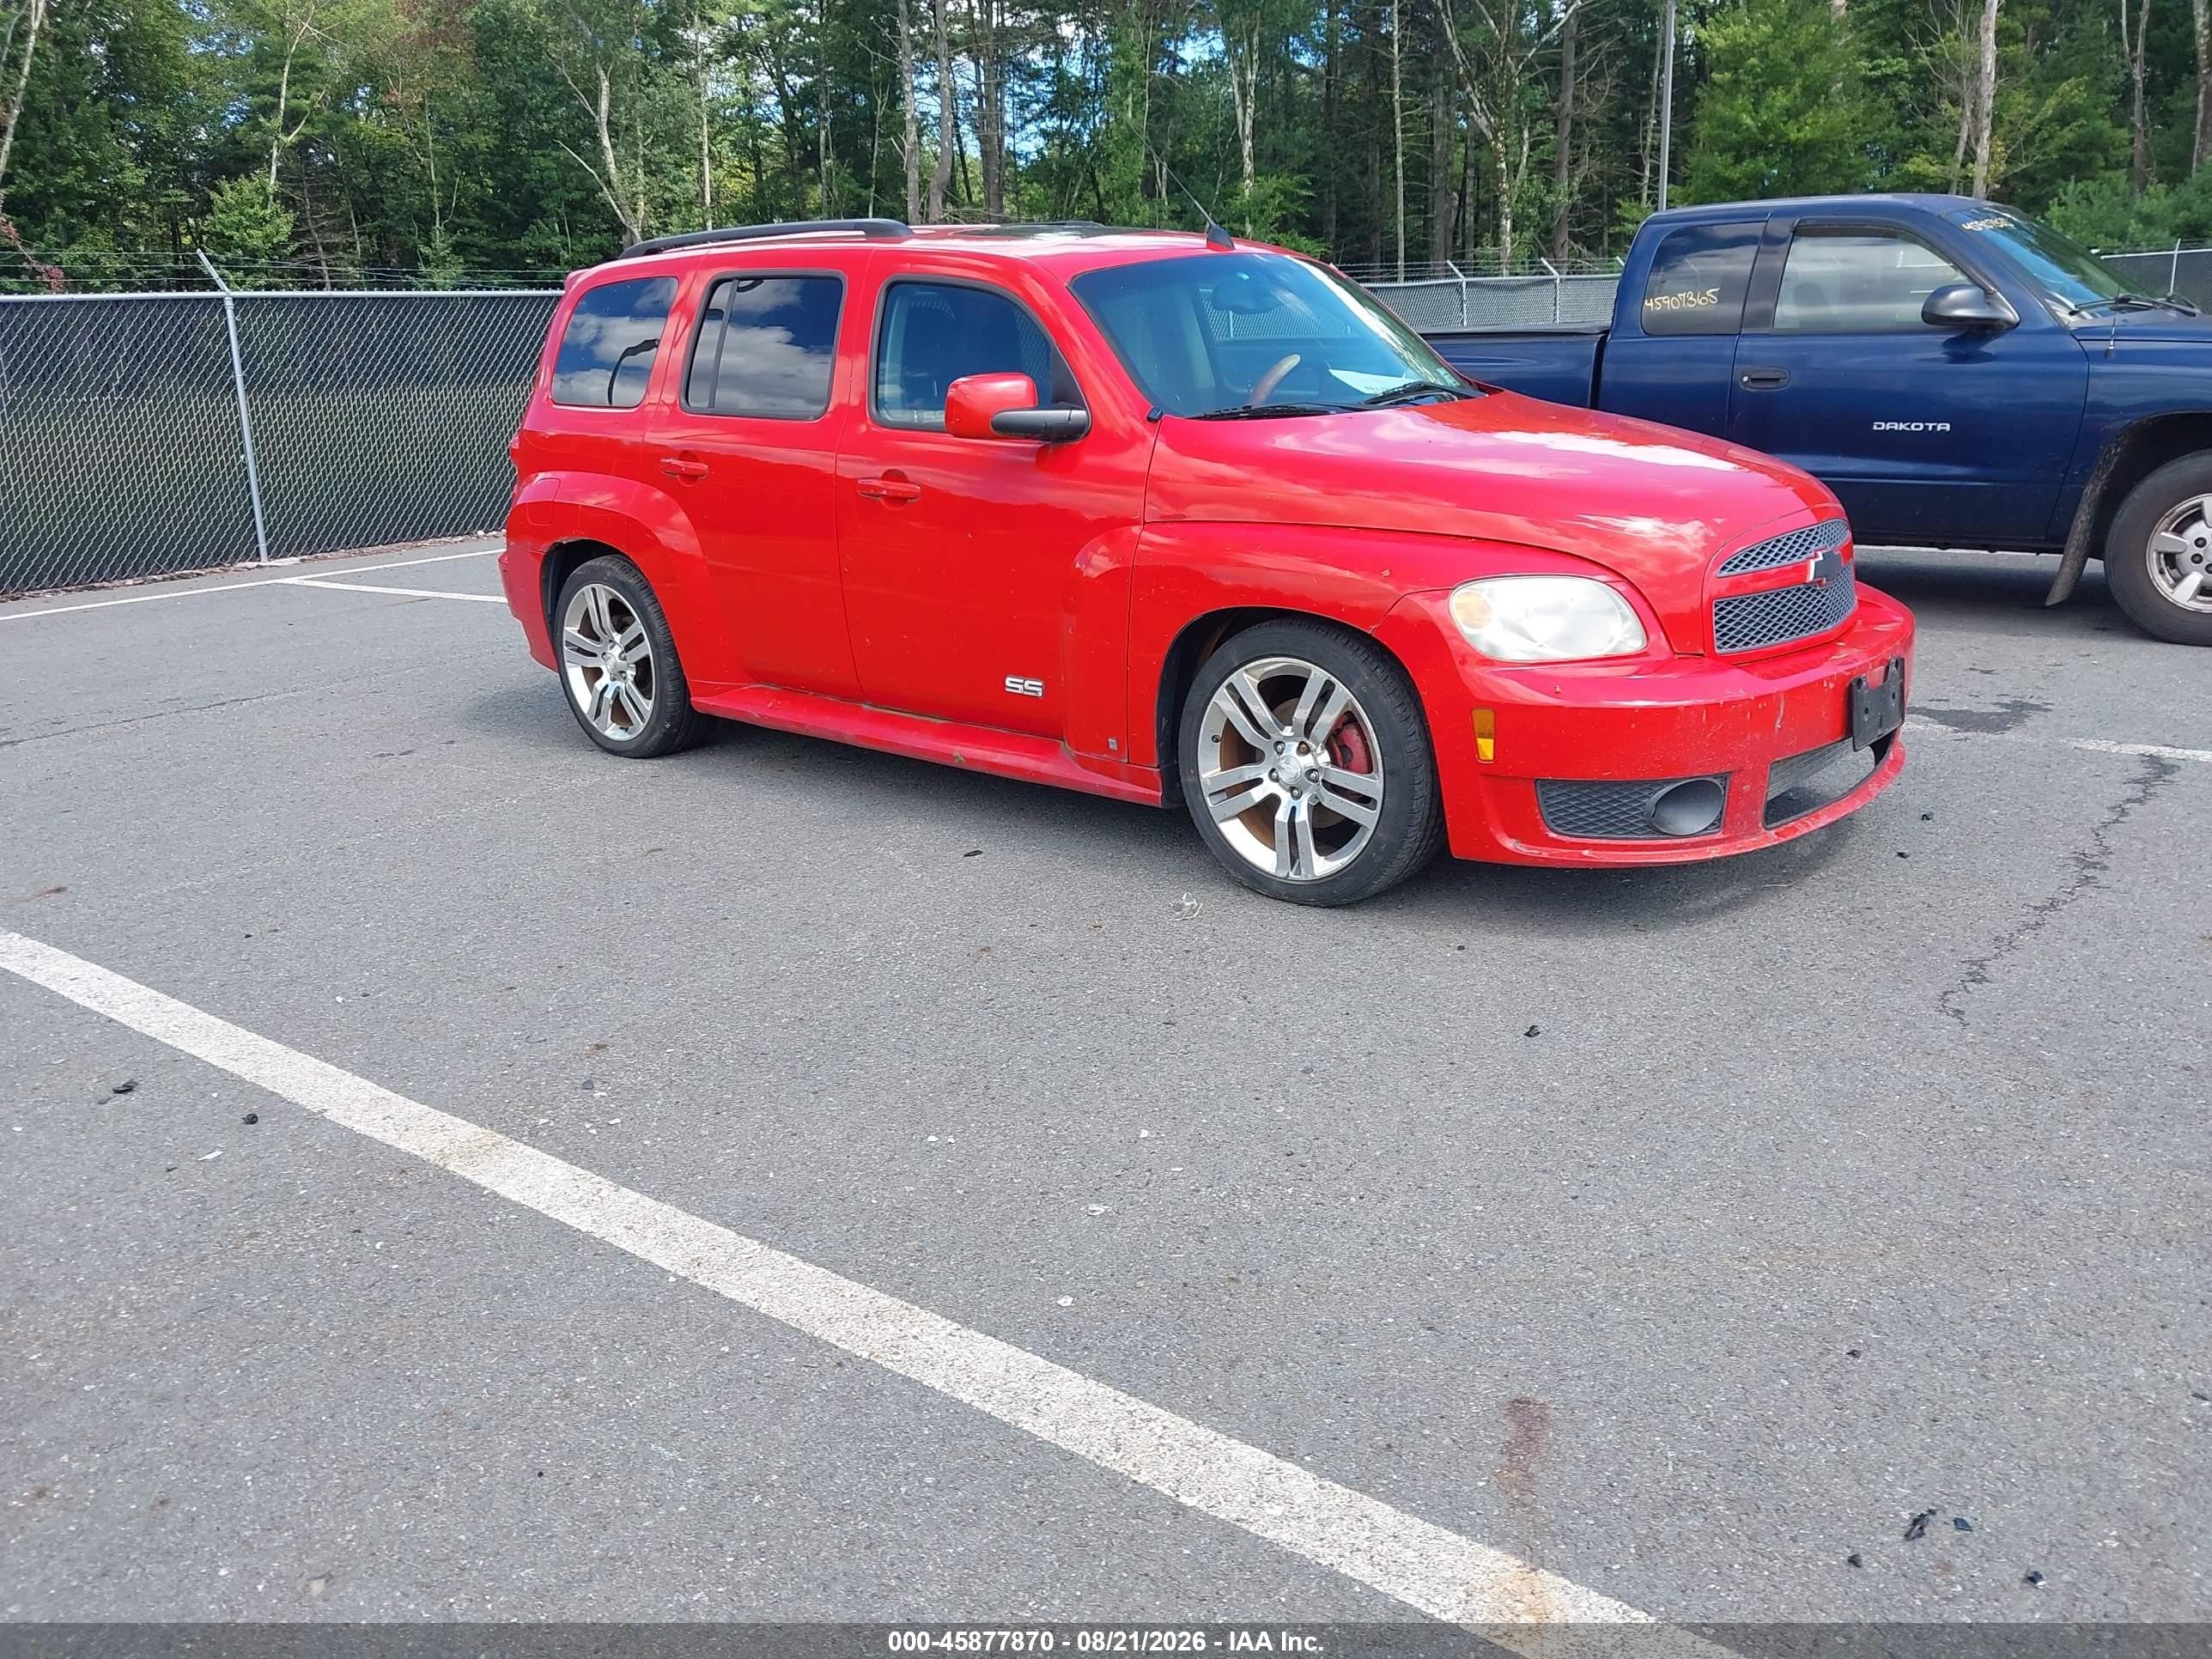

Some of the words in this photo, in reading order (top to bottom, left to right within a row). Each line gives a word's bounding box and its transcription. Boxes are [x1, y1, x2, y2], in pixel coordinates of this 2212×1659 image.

[1644, 288, 1721, 312] 45907365
[1873, 422, 1950, 432] DAKOTA
[1005, 676, 1043, 697] SS
